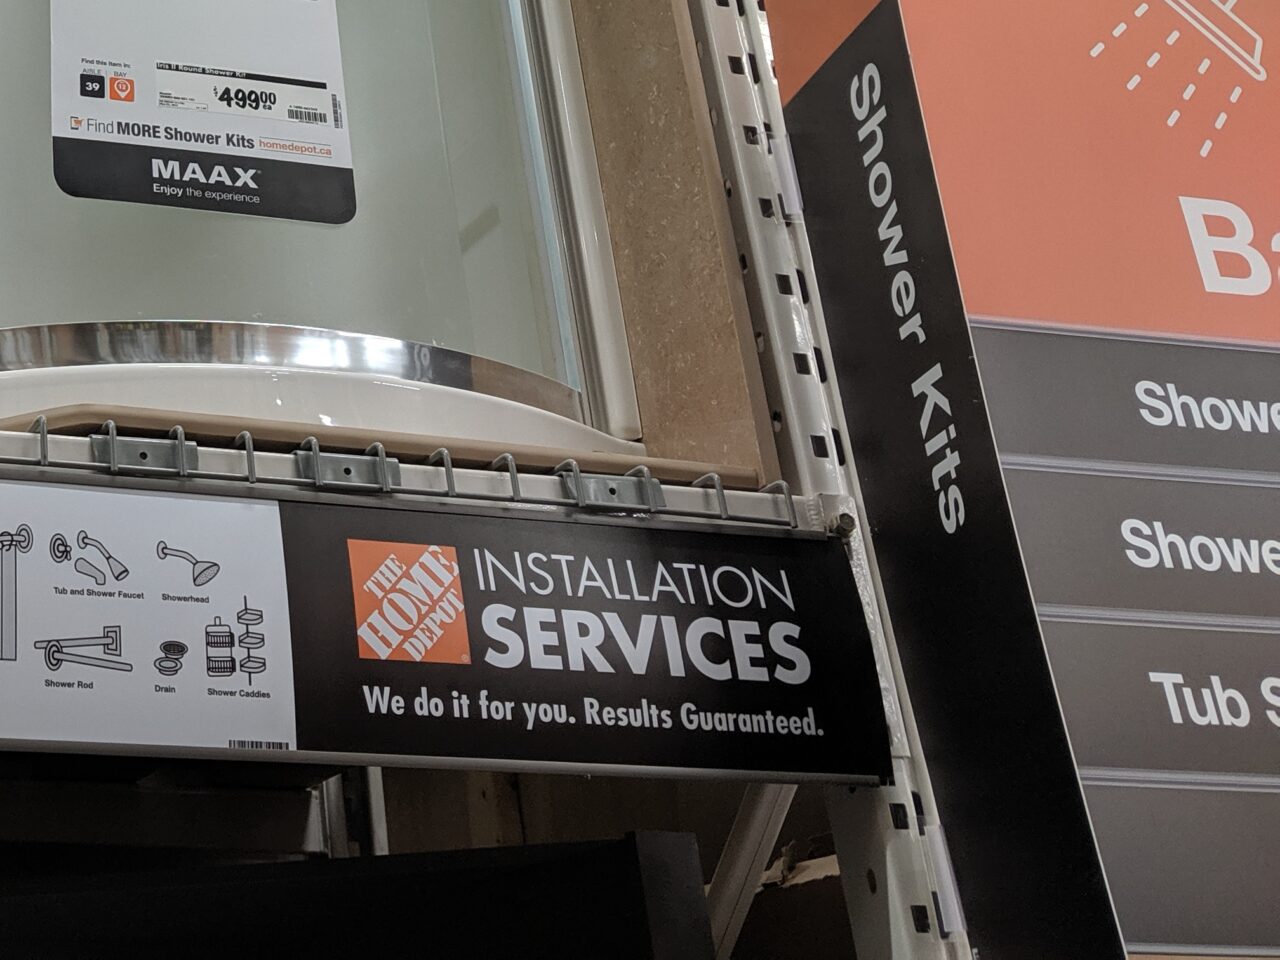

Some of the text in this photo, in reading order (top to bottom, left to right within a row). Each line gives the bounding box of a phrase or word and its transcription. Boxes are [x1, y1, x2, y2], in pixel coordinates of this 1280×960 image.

[85, 82, 100, 91] 39
[205, 67, 233, 77] Shower
[86, 119, 332, 157] Find MORE Shower Kits homedepot.ca
[151, 158, 259, 189] MAAX
[153, 183, 260, 204] Enjoy the experience
[850, 62, 965, 535] Shower Kits
[53, 586, 145, 600] Tub and Shower Faucet
[363, 554, 406, 599] THE
[473, 547, 796, 612] INSTALLATION
[161, 593, 210, 604] Showerhead
[357, 545, 459, 660] HOME
[402, 588, 465, 662] DEPOT
[481, 603, 811, 685] SERVICES
[44, 678, 94, 690] Shower Rod
[154, 684, 176, 694] Drain
[207, 687, 271, 699] Shower Caddies
[1148, 672, 1251, 728] Tub
[362, 685, 825, 737] We do it for you. Results Guaranteed.
